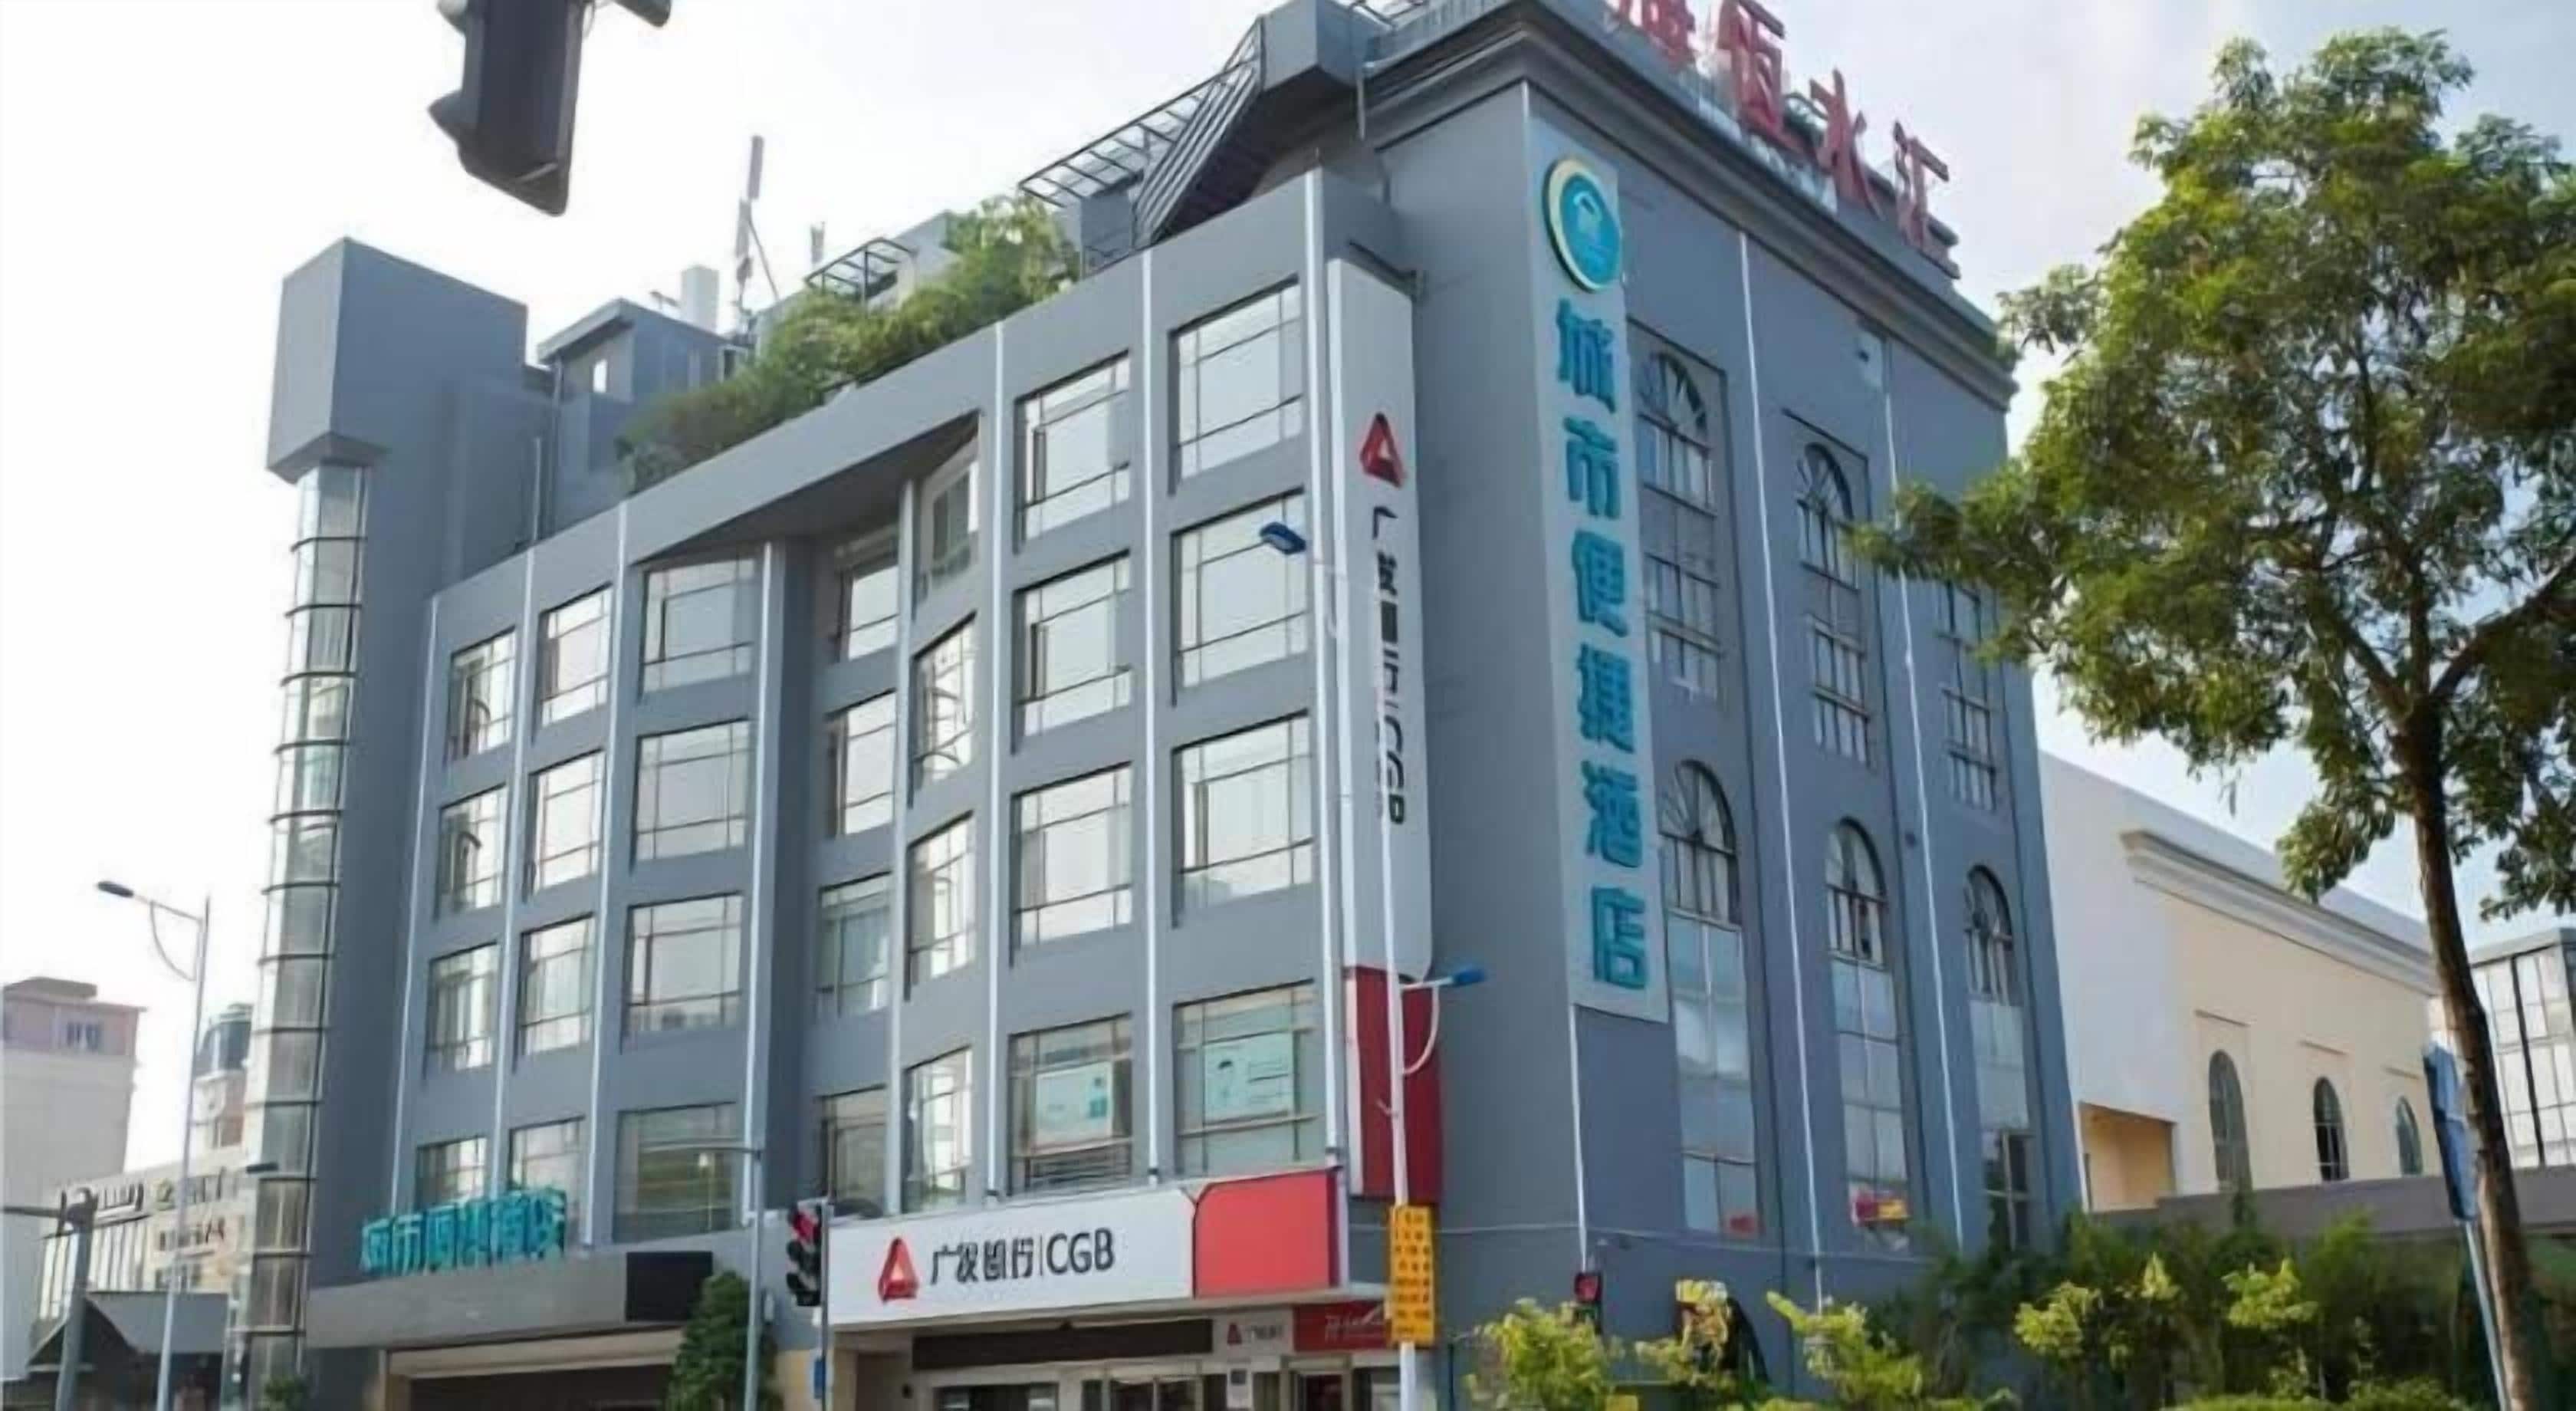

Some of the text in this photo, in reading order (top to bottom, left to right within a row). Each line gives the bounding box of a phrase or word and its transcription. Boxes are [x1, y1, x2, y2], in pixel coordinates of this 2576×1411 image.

[1556, 297, 1648, 991] 城市便捷酒店
[929, 1227, 1116, 1285] 广发银行 CGB
